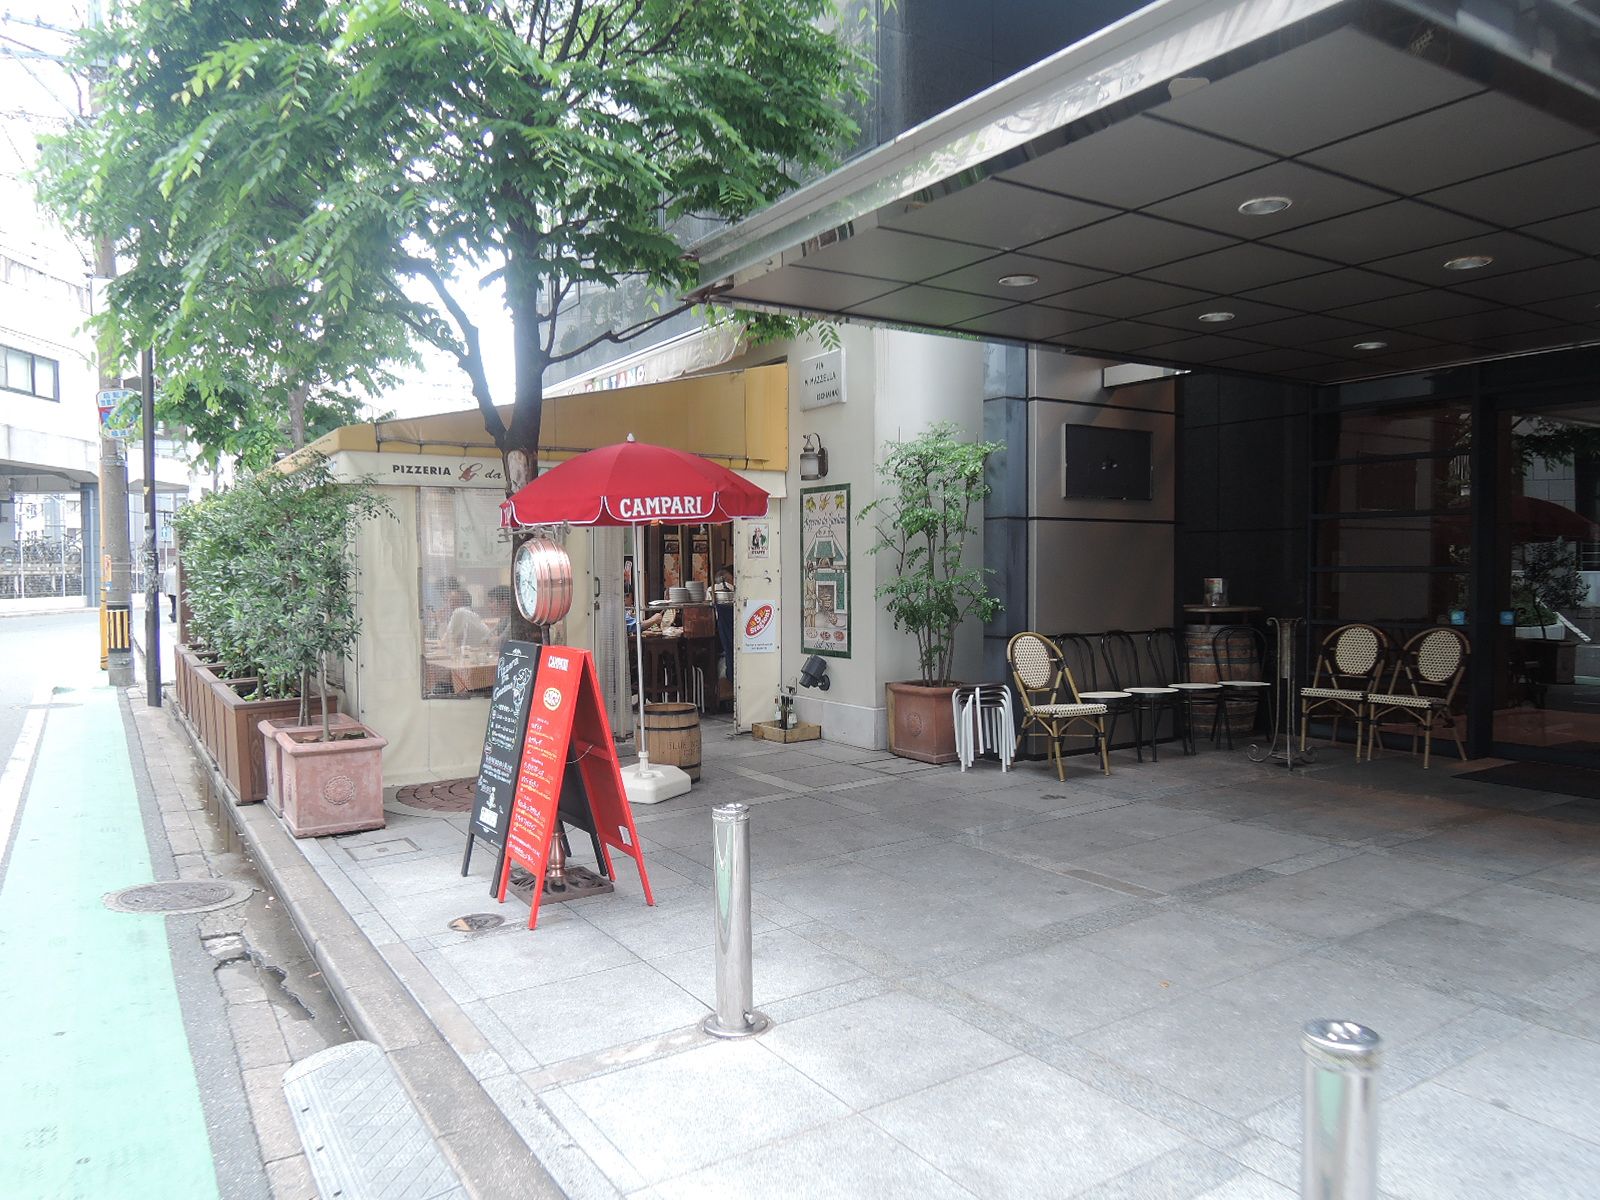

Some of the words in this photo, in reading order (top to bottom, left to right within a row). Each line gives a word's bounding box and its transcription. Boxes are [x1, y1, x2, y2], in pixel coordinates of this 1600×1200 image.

[392, 464, 452, 476] PIZZERIA
[484, 469, 503, 479] da
[619, 495, 702, 518] CAMPARI
